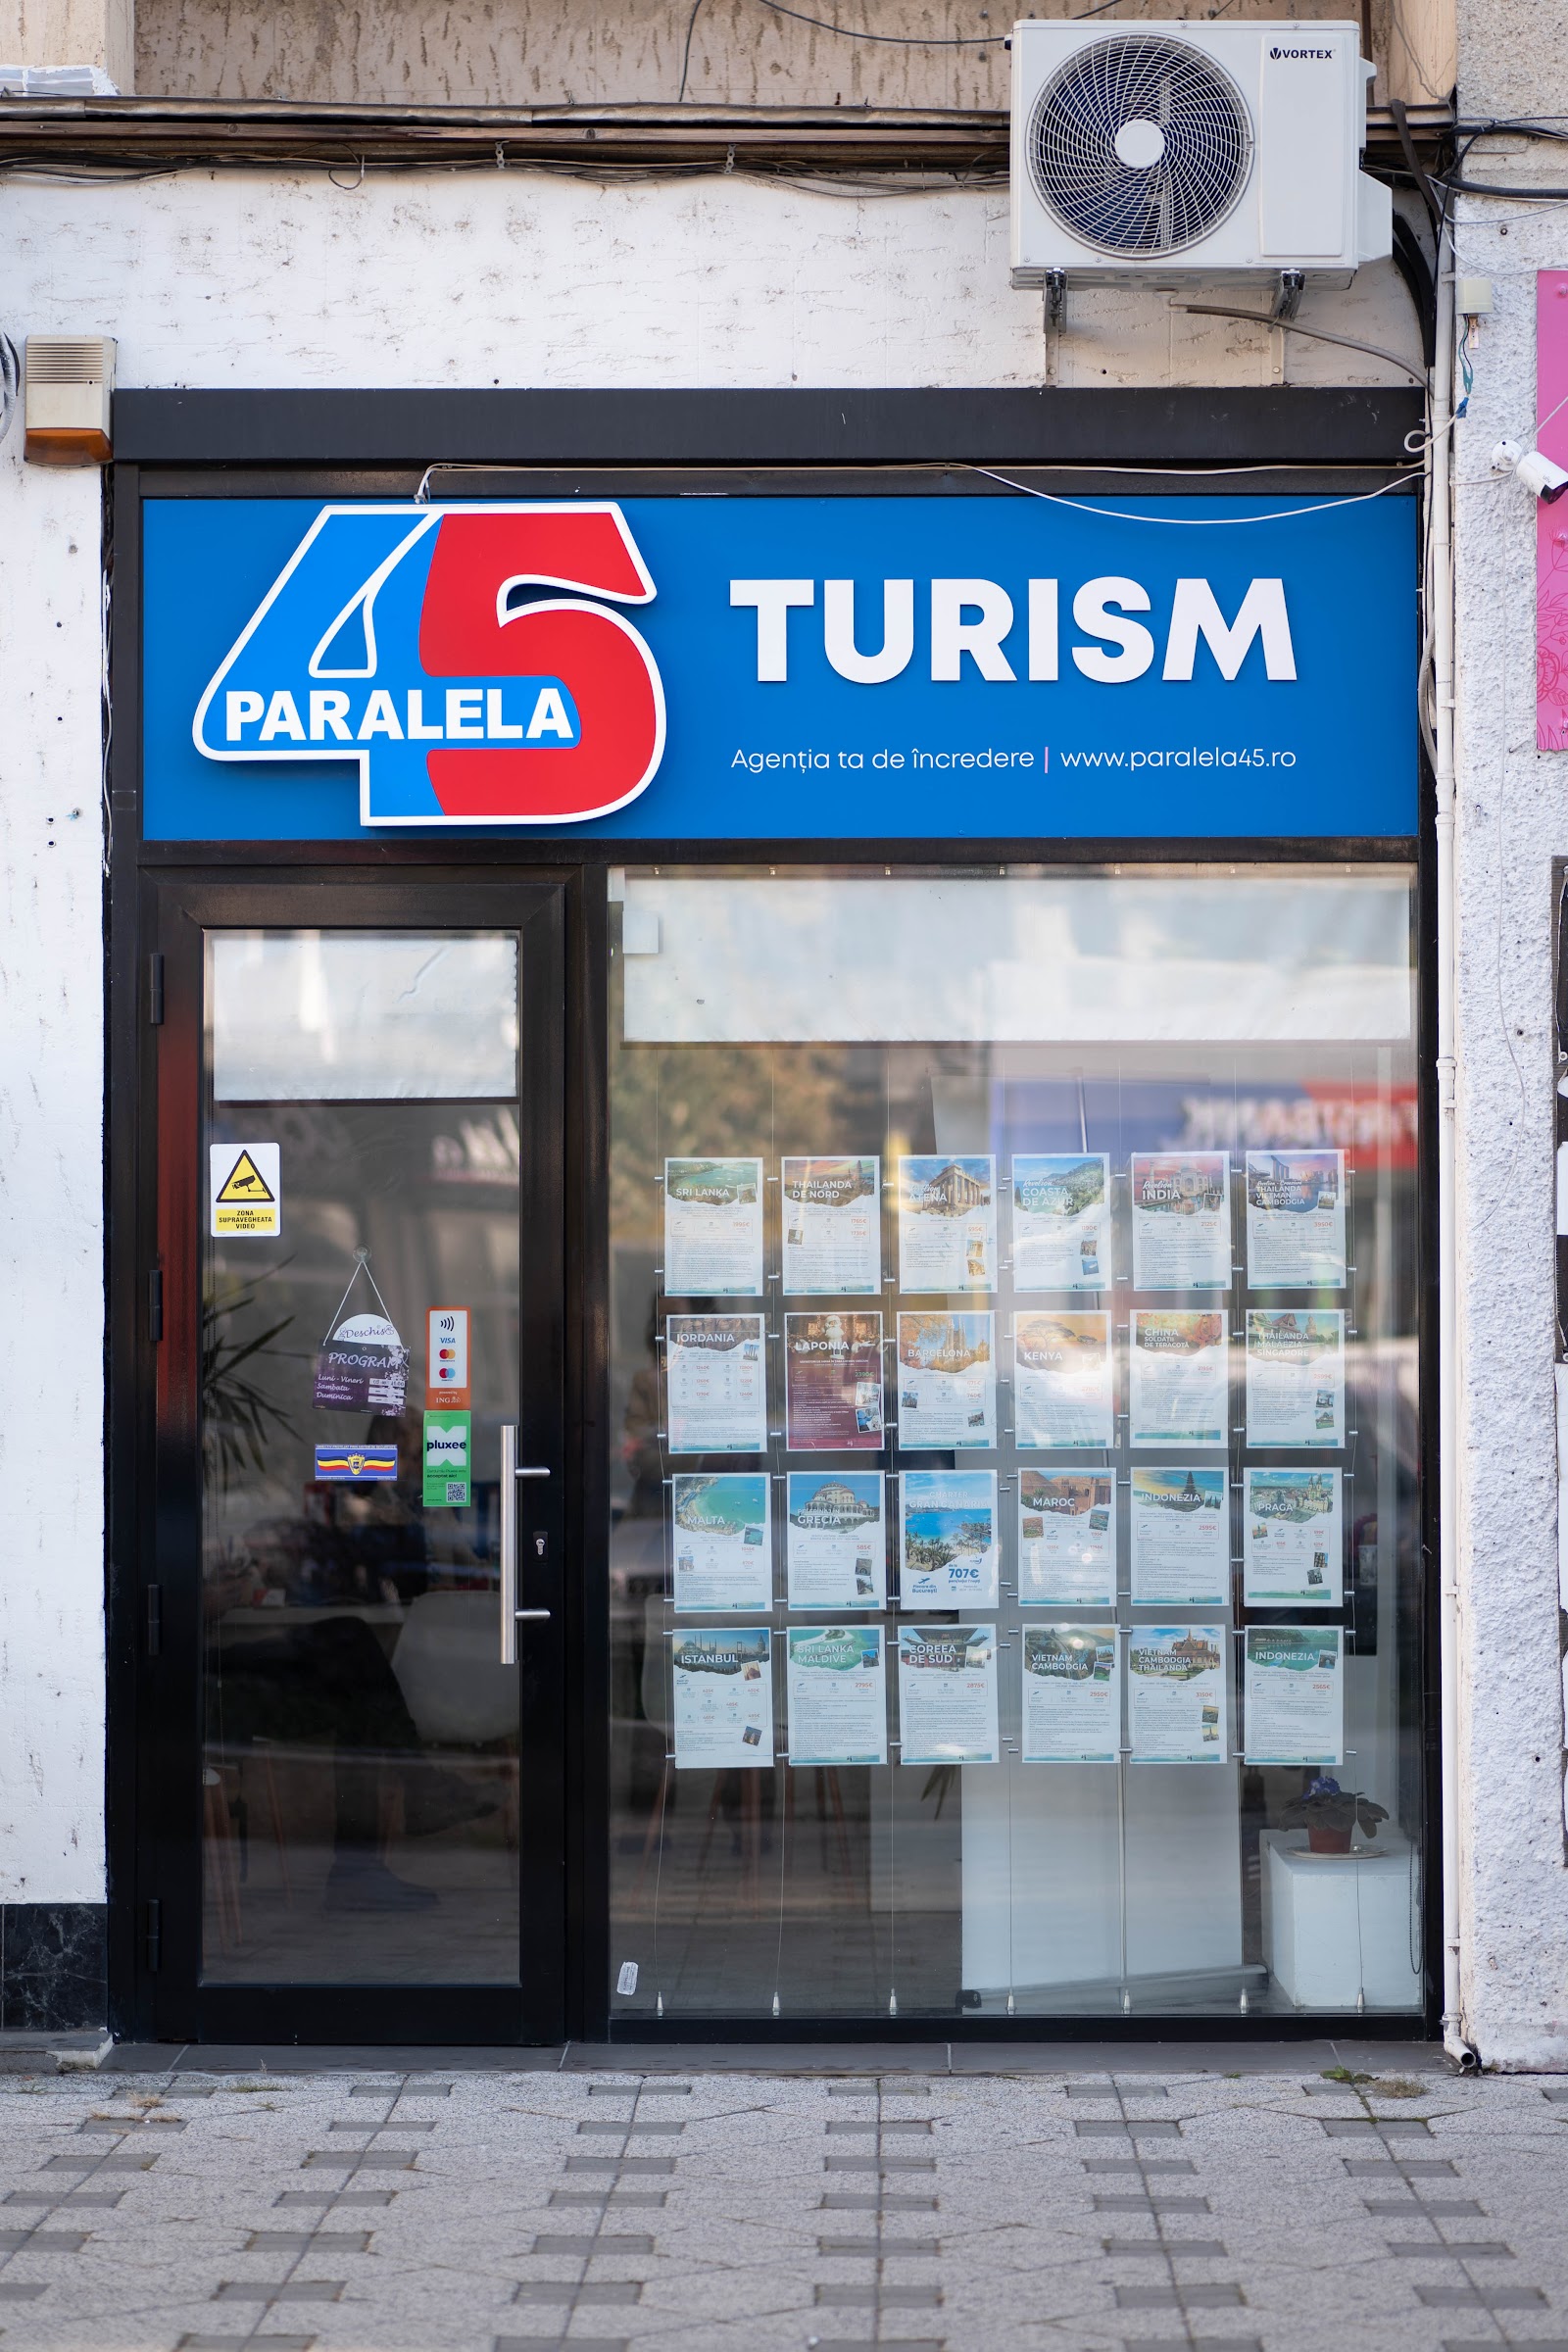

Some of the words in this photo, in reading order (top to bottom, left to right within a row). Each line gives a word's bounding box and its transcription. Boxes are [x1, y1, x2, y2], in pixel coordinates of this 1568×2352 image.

[1282, 49, 1333, 59] VORTEX
[729, 575, 1298, 684] TURISM
[192, 502, 667, 827] 45
[224, 687, 574, 742] PARALELA
[730, 748, 832, 774] Agenția
[837, 751, 863, 769] ta
[871, 748, 905, 769] de
[911, 747, 1035, 769] încredere
[1059, 746, 1297, 772] www.paralela45.ro
[792, 1180, 853, 1189] THAILANDA
[676, 1188, 693, 1197] SRI
[695, 1188, 730, 1197] LANKA
[792, 1190, 807, 1199] DE
[809, 1190, 840, 1199] NORD
[1022, 1187, 1069, 1197] COASTA
[1142, 1189, 1181, 1200] INDIA
[909, 1193, 948, 1202] ATENA
[1022, 1198, 1039, 1206] DE
[1144, 1328, 1179, 1337] CHINA
[676, 1333, 735, 1343] IORDANIA
[795, 1341, 850, 1350] LAPONIA
[907, 1348, 971, 1357] BARCELONA
[1024, 1351, 1063, 1360] KENYA
[1256, 1348, 1309, 1357] SINGAPORE
[328, 1351, 399, 1369] PROGRAM
[318, 1373, 335, 1382] Luni
[340, 1375, 364, 1384] Vineri
[316, 1382, 350, 1392] Sambata
[316, 1392, 354, 1401] Duminica
[426, 1440, 466, 1451] pluxee
[1033, 1497, 1075, 1507] MAROC
[1142, 1494, 1200, 1502] INDONEZIA
[1258, 1502, 1294, 1512] PRAGA
[687, 1515, 725, 1525] MALTA
[797, 1515, 842, 1525] GRECIA
[948, 1568, 979, 1579] 707€
[818, 1644, 855, 1653] LANKA
[908, 1644, 956, 1654] COREEA
[681, 1653, 739, 1664] ISTANBUL
[798, 1654, 847, 1663] MALDIVE
[909, 1654, 925, 1664] DE
[928, 1654, 953, 1664] SUD
[1255, 1651, 1315, 1661] INDONEZIA
[1031, 1662, 1089, 1671] CAMBODGIA
